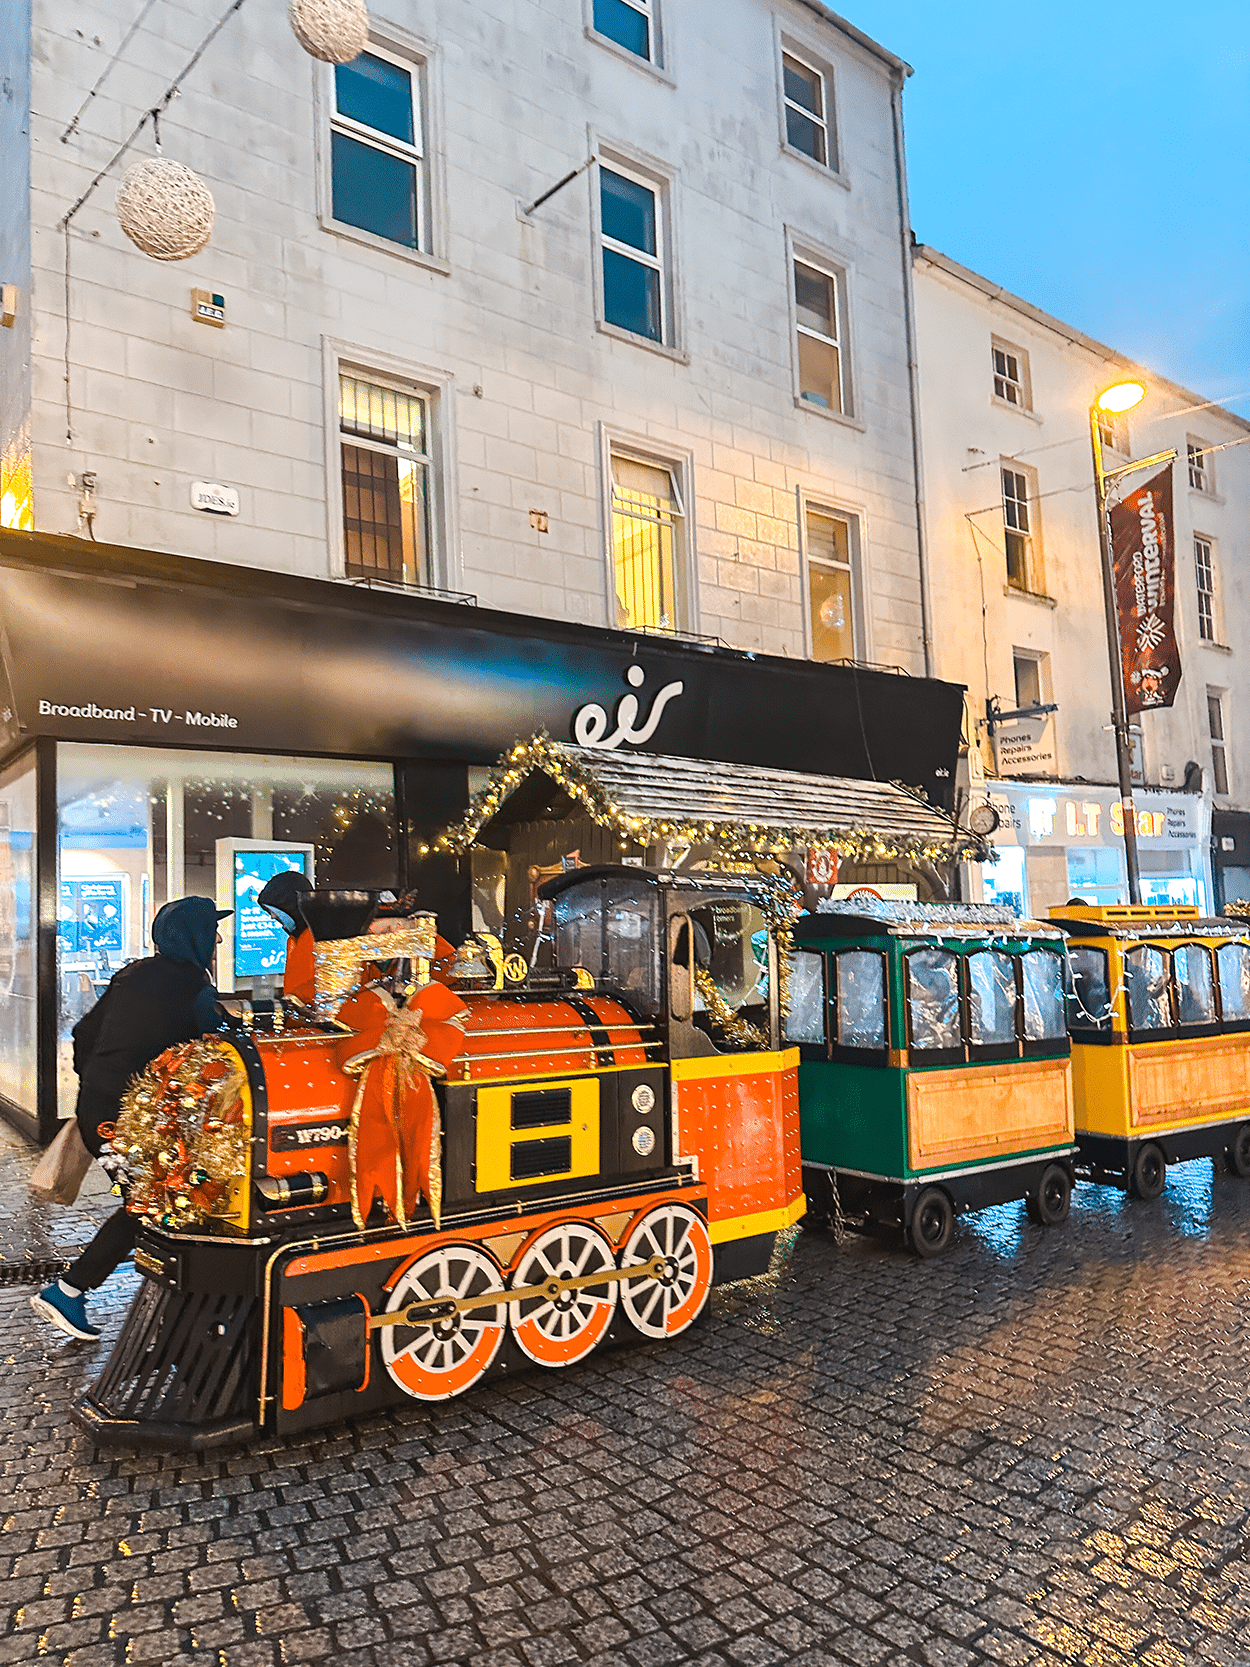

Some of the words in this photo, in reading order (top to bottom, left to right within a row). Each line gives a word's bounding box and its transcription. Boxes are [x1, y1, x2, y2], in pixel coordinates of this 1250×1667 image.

[574, 665, 684, 749] eir
[38, 700, 136, 722] Broadband
[149, 707, 173, 724] TV
[185, 711, 239, 729] Mobile
[1000, 734, 1031, 745] Phones
[1000, 744, 1032, 756] Repairs
[1001, 752, 1053, 766] Accessories
